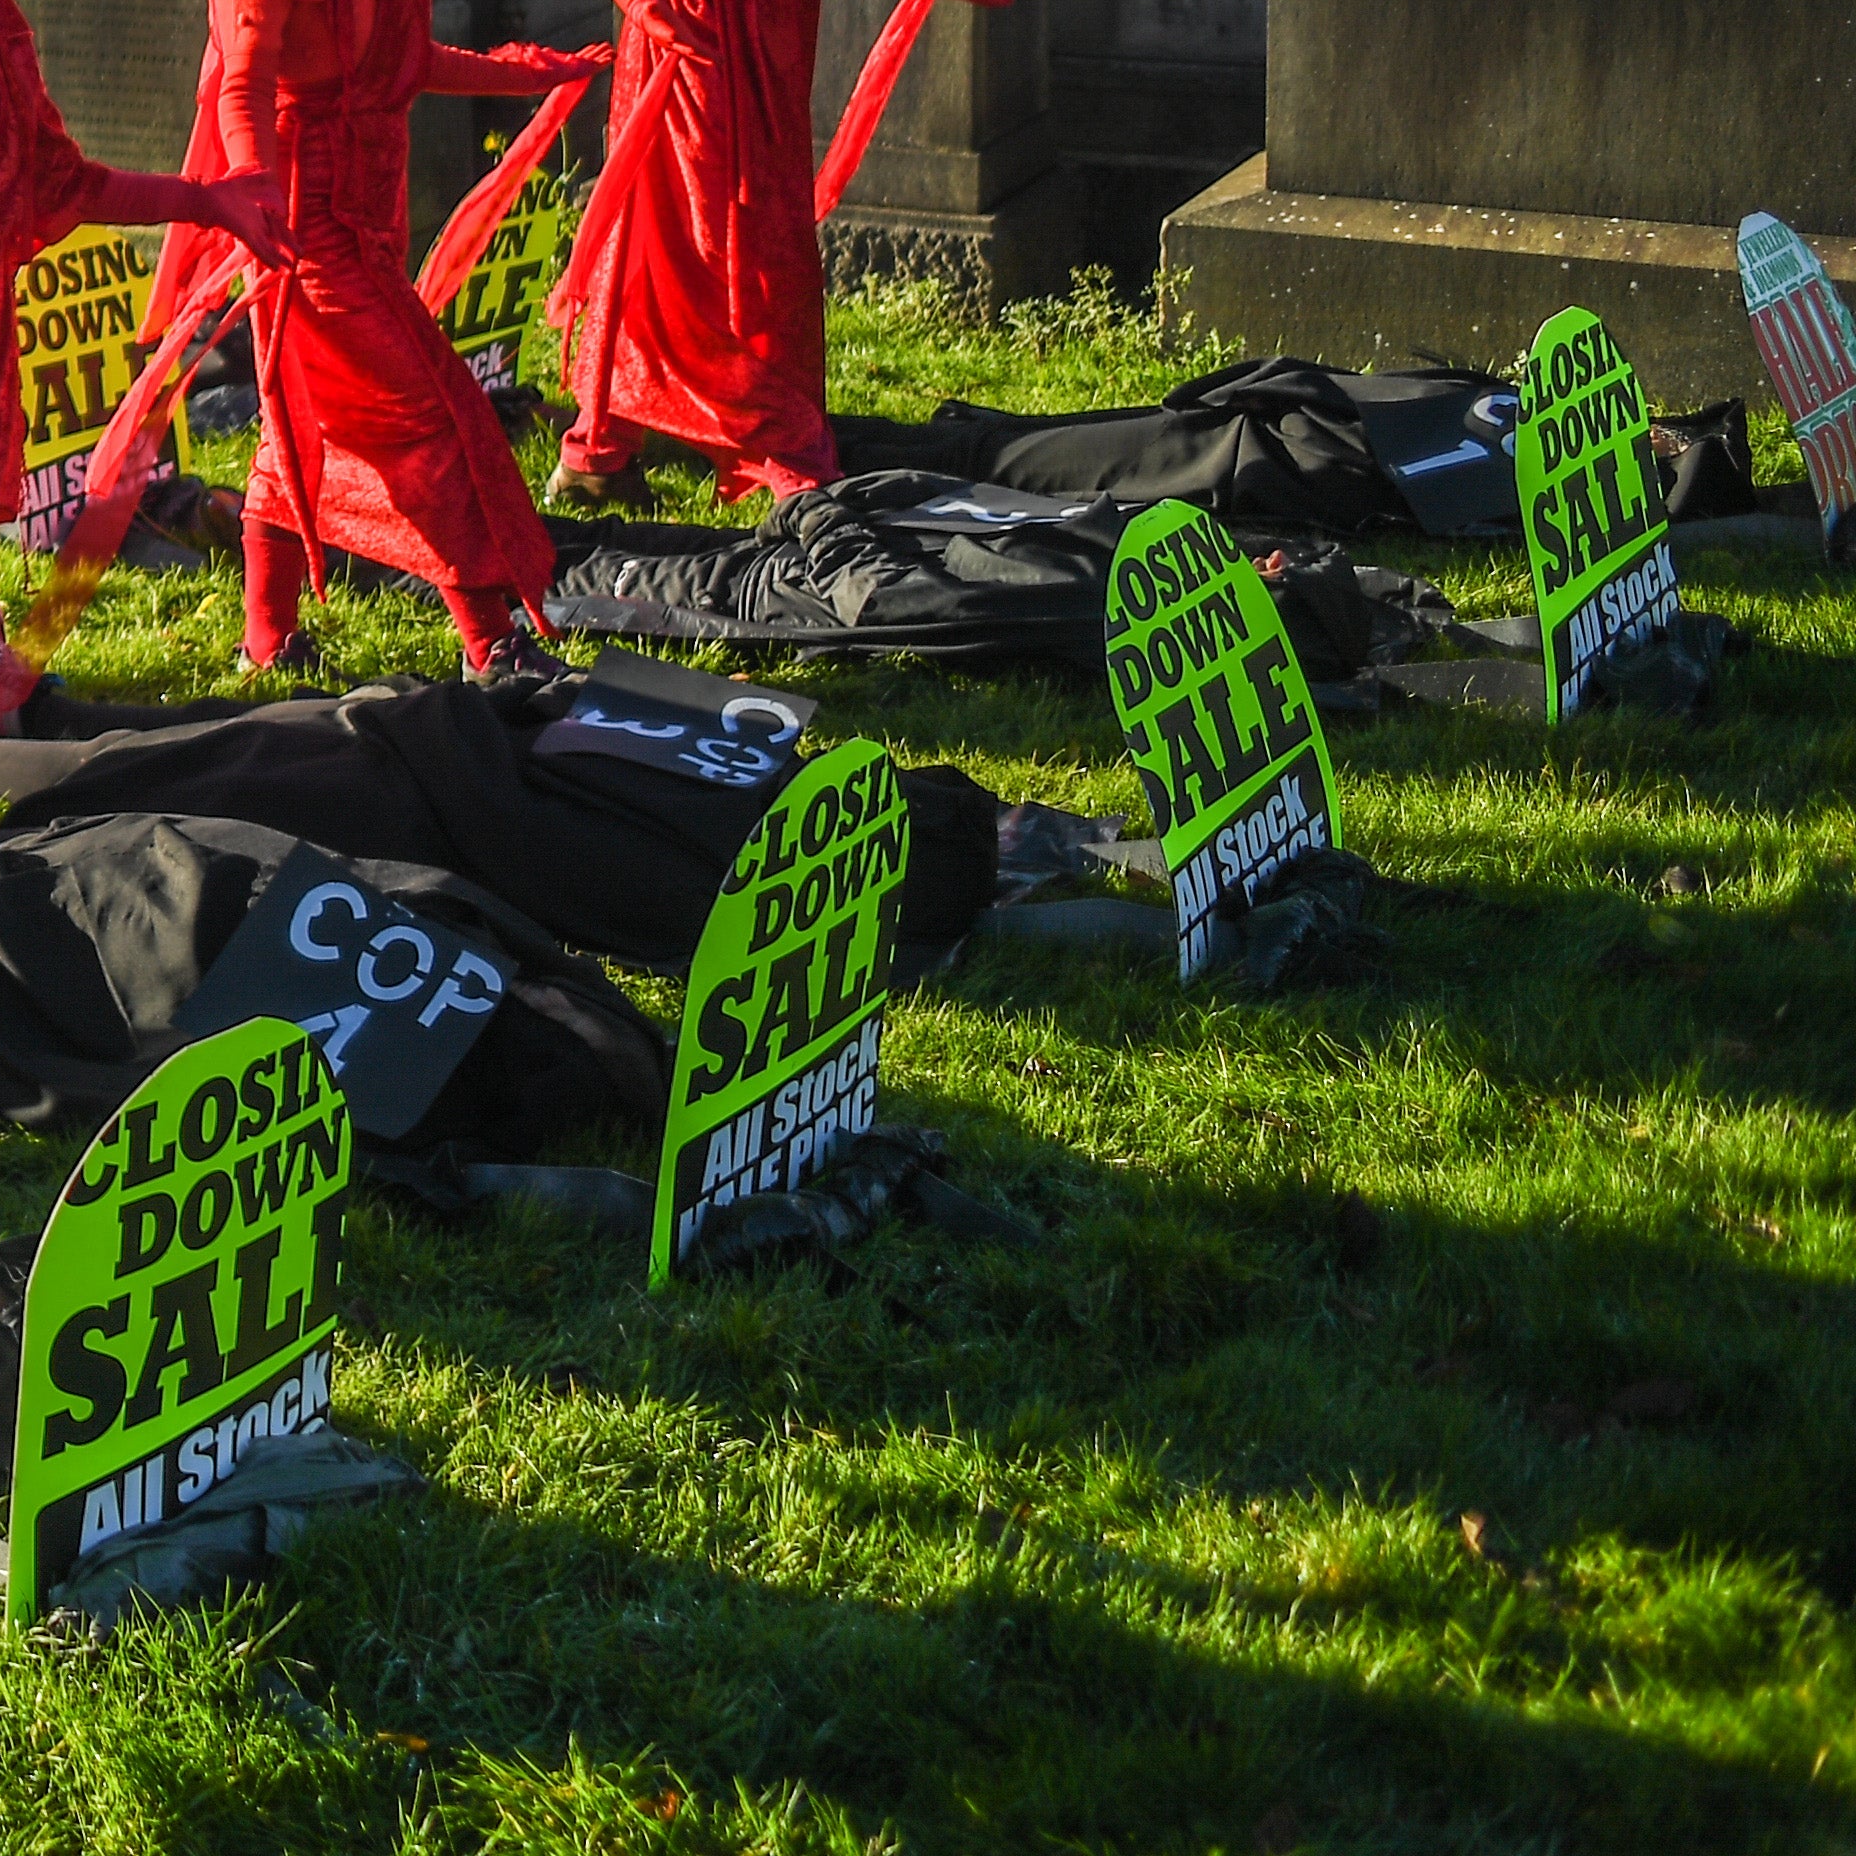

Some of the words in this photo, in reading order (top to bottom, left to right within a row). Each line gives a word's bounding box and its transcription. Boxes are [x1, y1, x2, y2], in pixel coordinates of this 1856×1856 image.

[17, 291, 135, 357] DOWN
[1538, 372, 1641, 475] DOWN
[1107, 581, 1250, 712] DOWN
[1569, 596, 1604, 672] All
[1600, 541, 1677, 635] Stock
[748, 813, 909, 955] DOWN
[1173, 846, 1218, 934] All
[1215, 771, 1308, 889] Stock
[290, 881, 503, 1028] COP
[701, 1100, 766, 1194] All
[771, 1017, 882, 1144] Stock
[114, 1105, 348, 1279] DOWN
[78, 1462, 164, 1556] All
[178, 1348, 330, 1505] Stock
